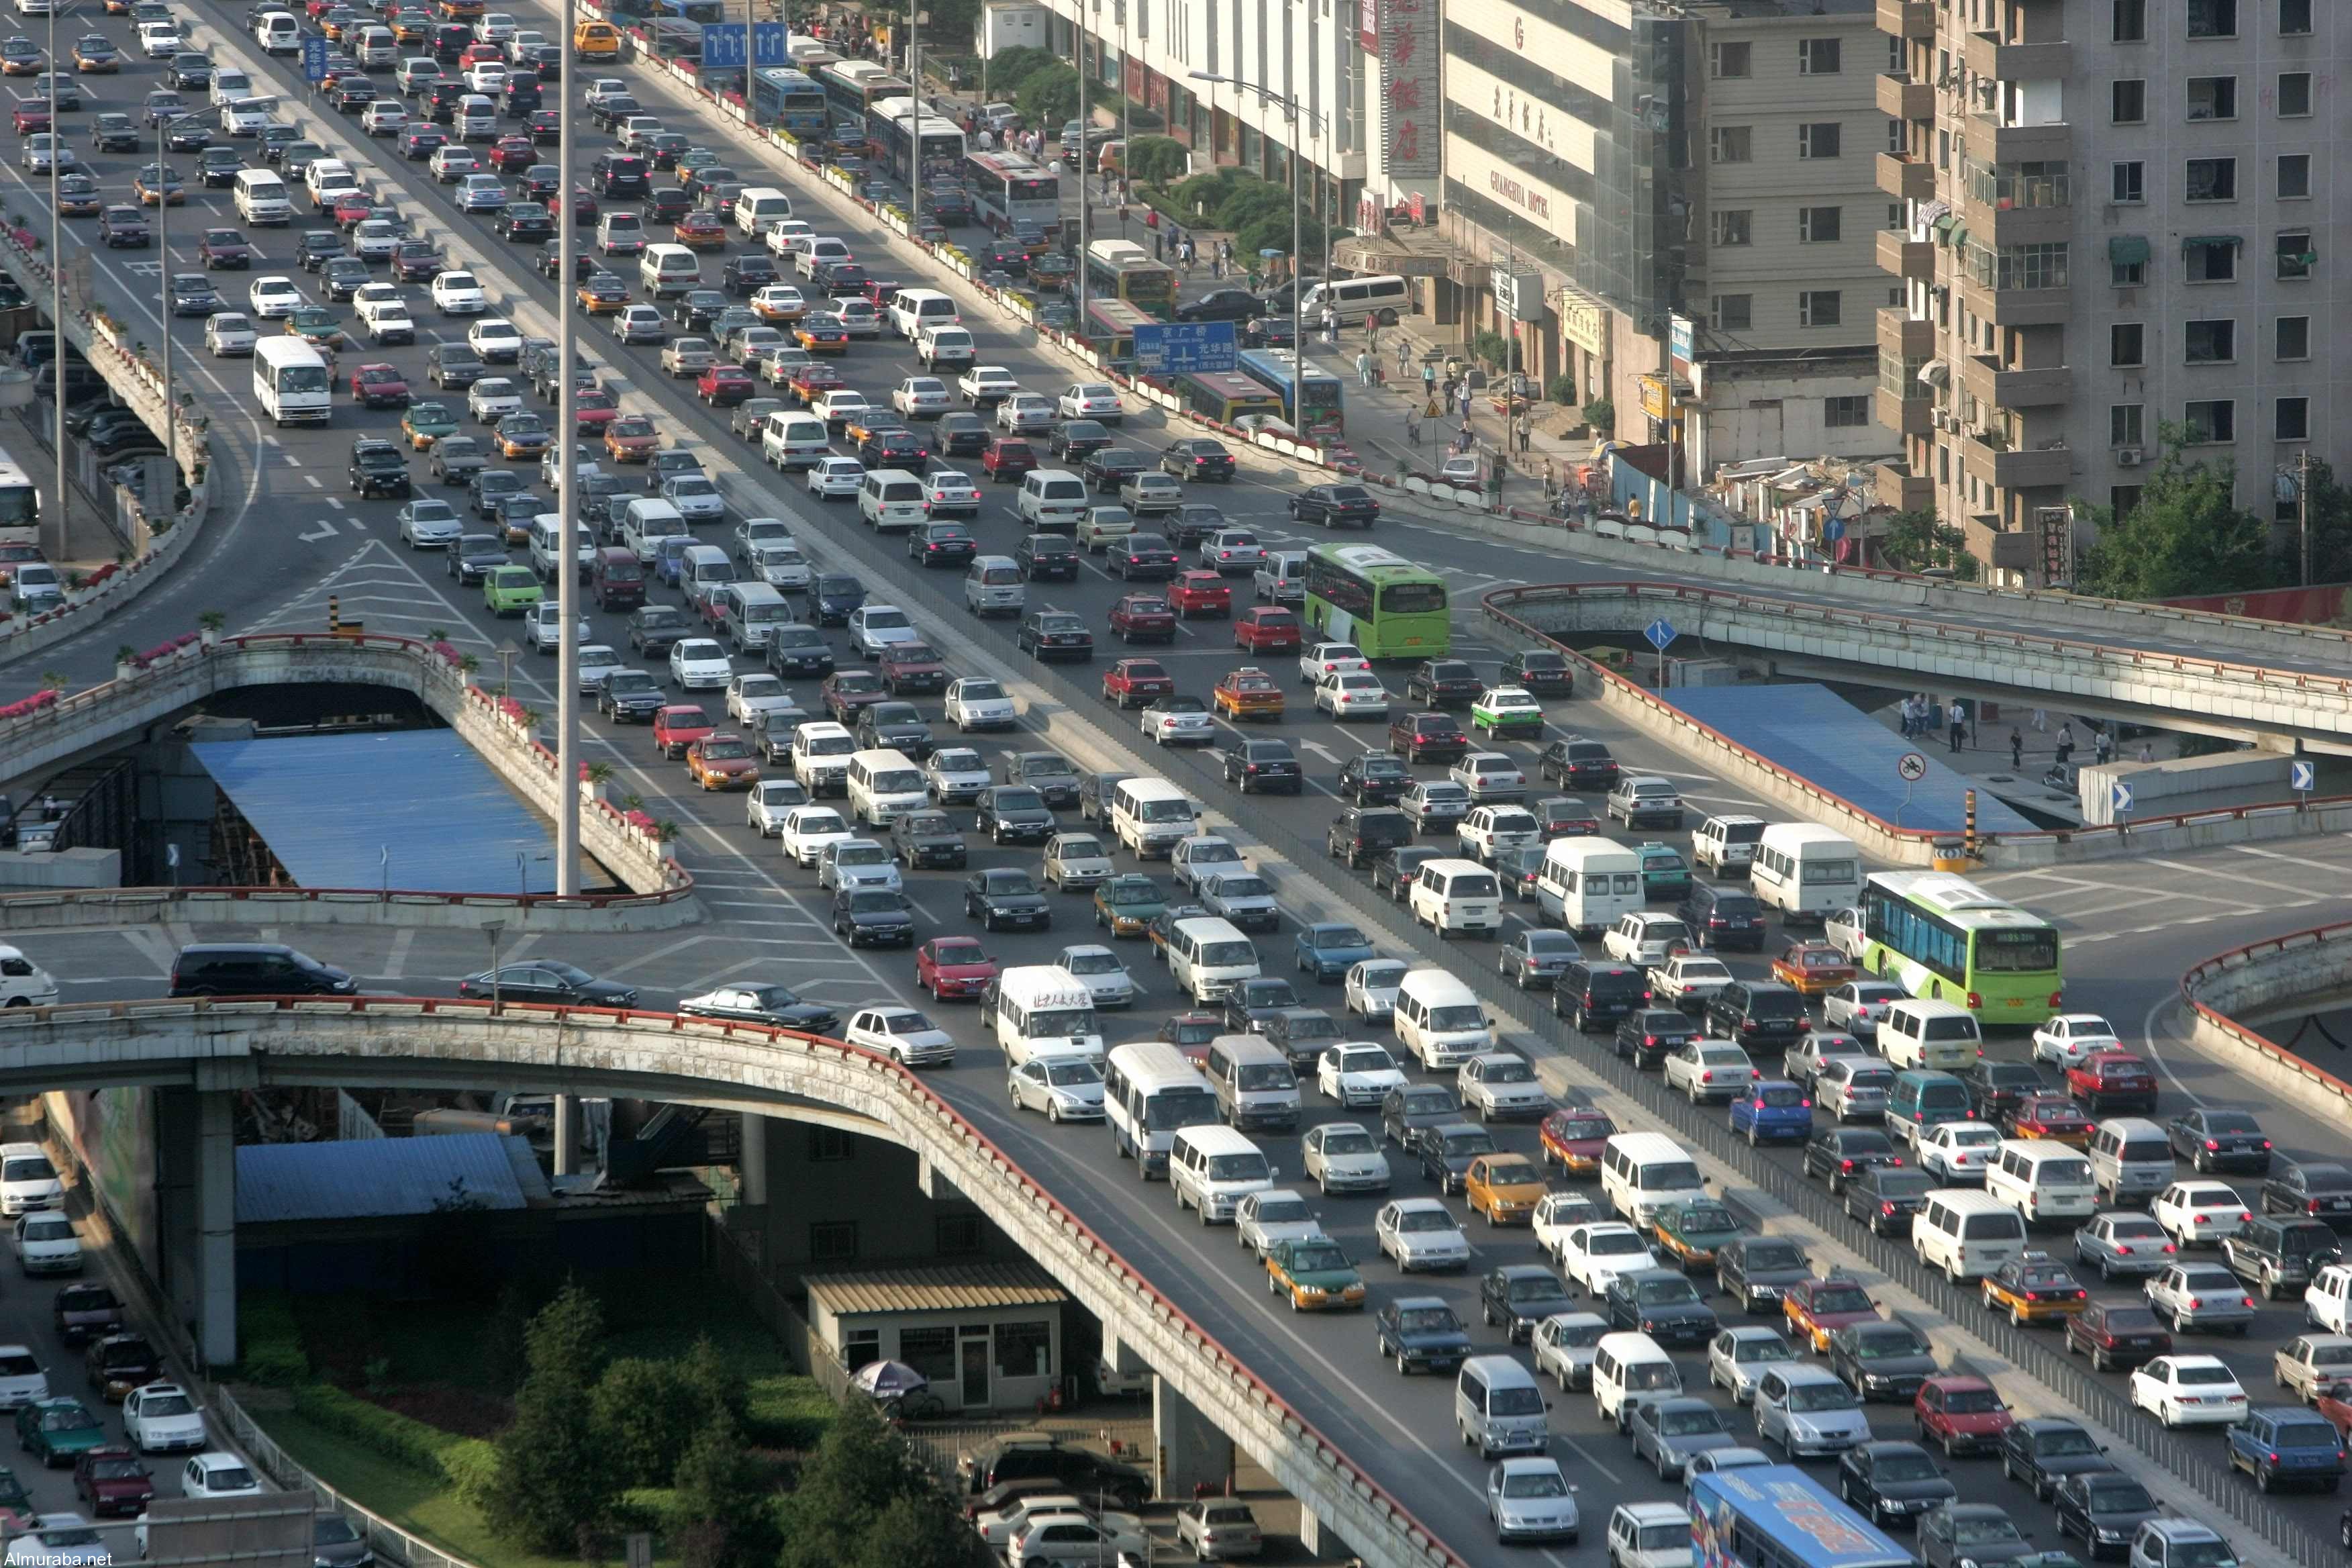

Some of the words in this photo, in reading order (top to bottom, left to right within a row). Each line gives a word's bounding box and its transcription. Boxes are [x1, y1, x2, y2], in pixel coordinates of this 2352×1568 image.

[1491, 170, 1526, 207] GUANGHUA
[1528, 189, 1549, 221] HOTEL
[1161, 325, 1208, 338] 京广桥
[1198, 342, 1233, 354] 光华路
